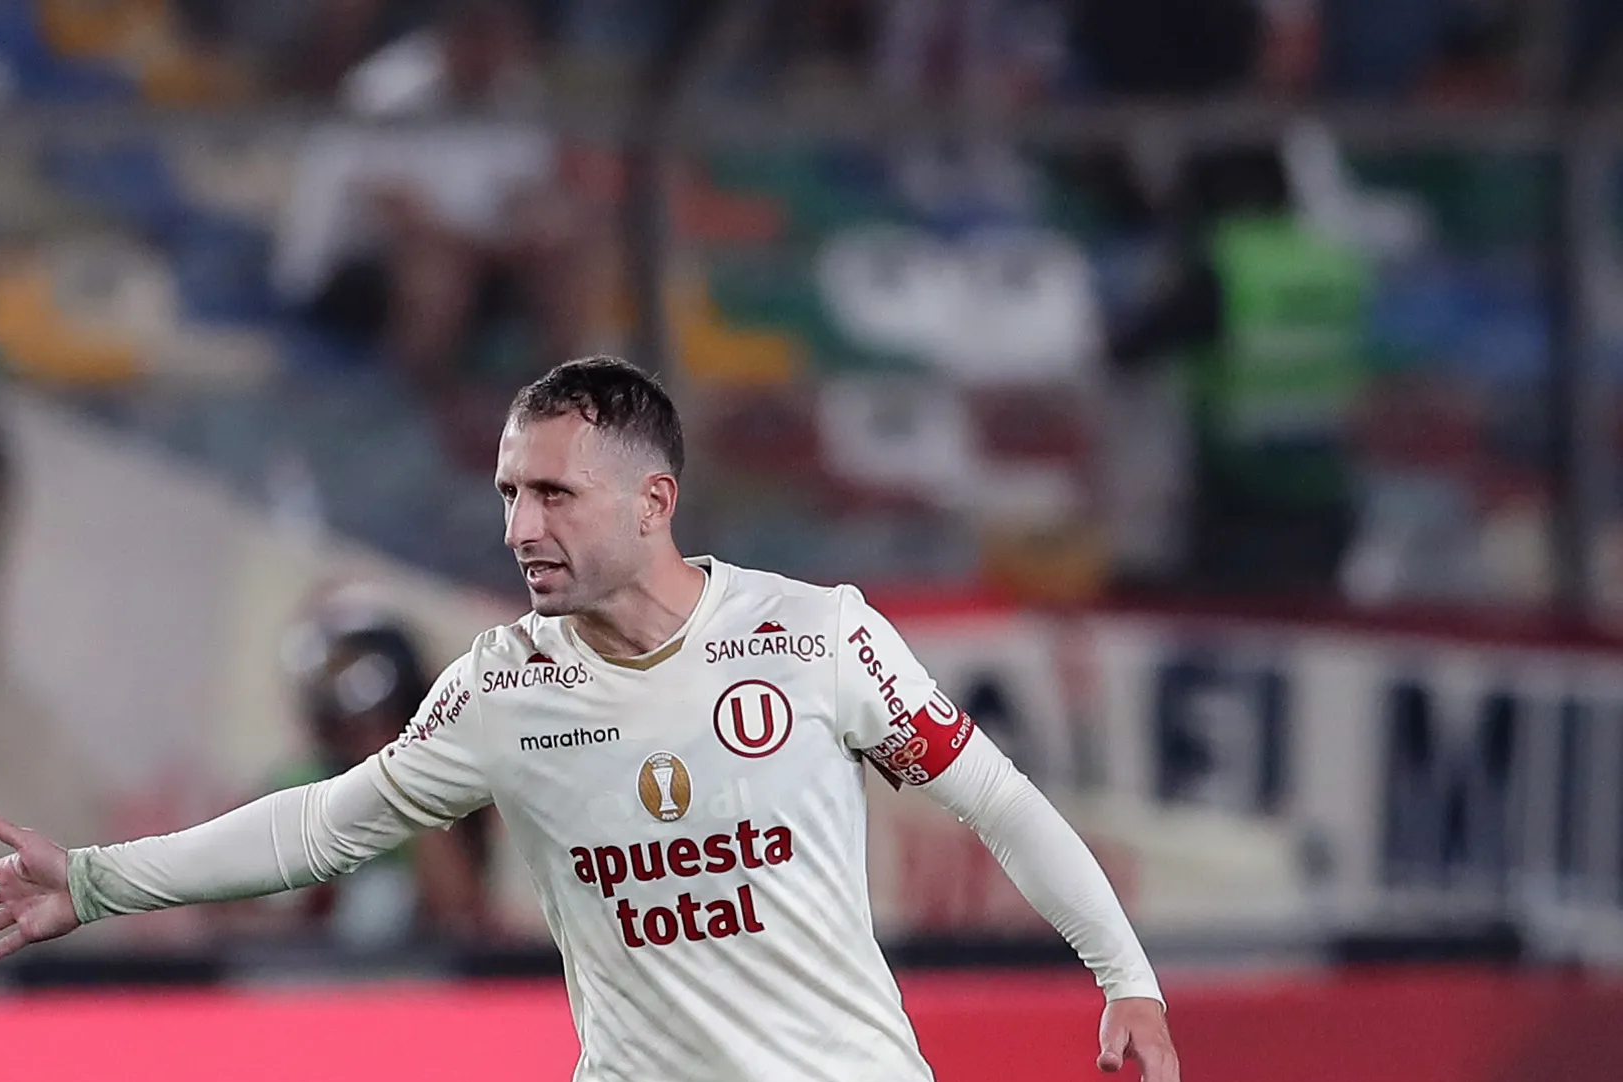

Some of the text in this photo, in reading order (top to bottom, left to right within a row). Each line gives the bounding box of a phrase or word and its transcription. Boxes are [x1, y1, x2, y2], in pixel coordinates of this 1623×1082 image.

[705, 635, 826, 663] SAN CARLOS
[482, 664, 588, 693] SAN CARLOS
[446, 689, 472, 724] Forte
[730, 693, 775, 749] U
[520, 726, 620, 751] marathon
[569, 819, 794, 898] apuesta
[616, 884, 765, 948] total
